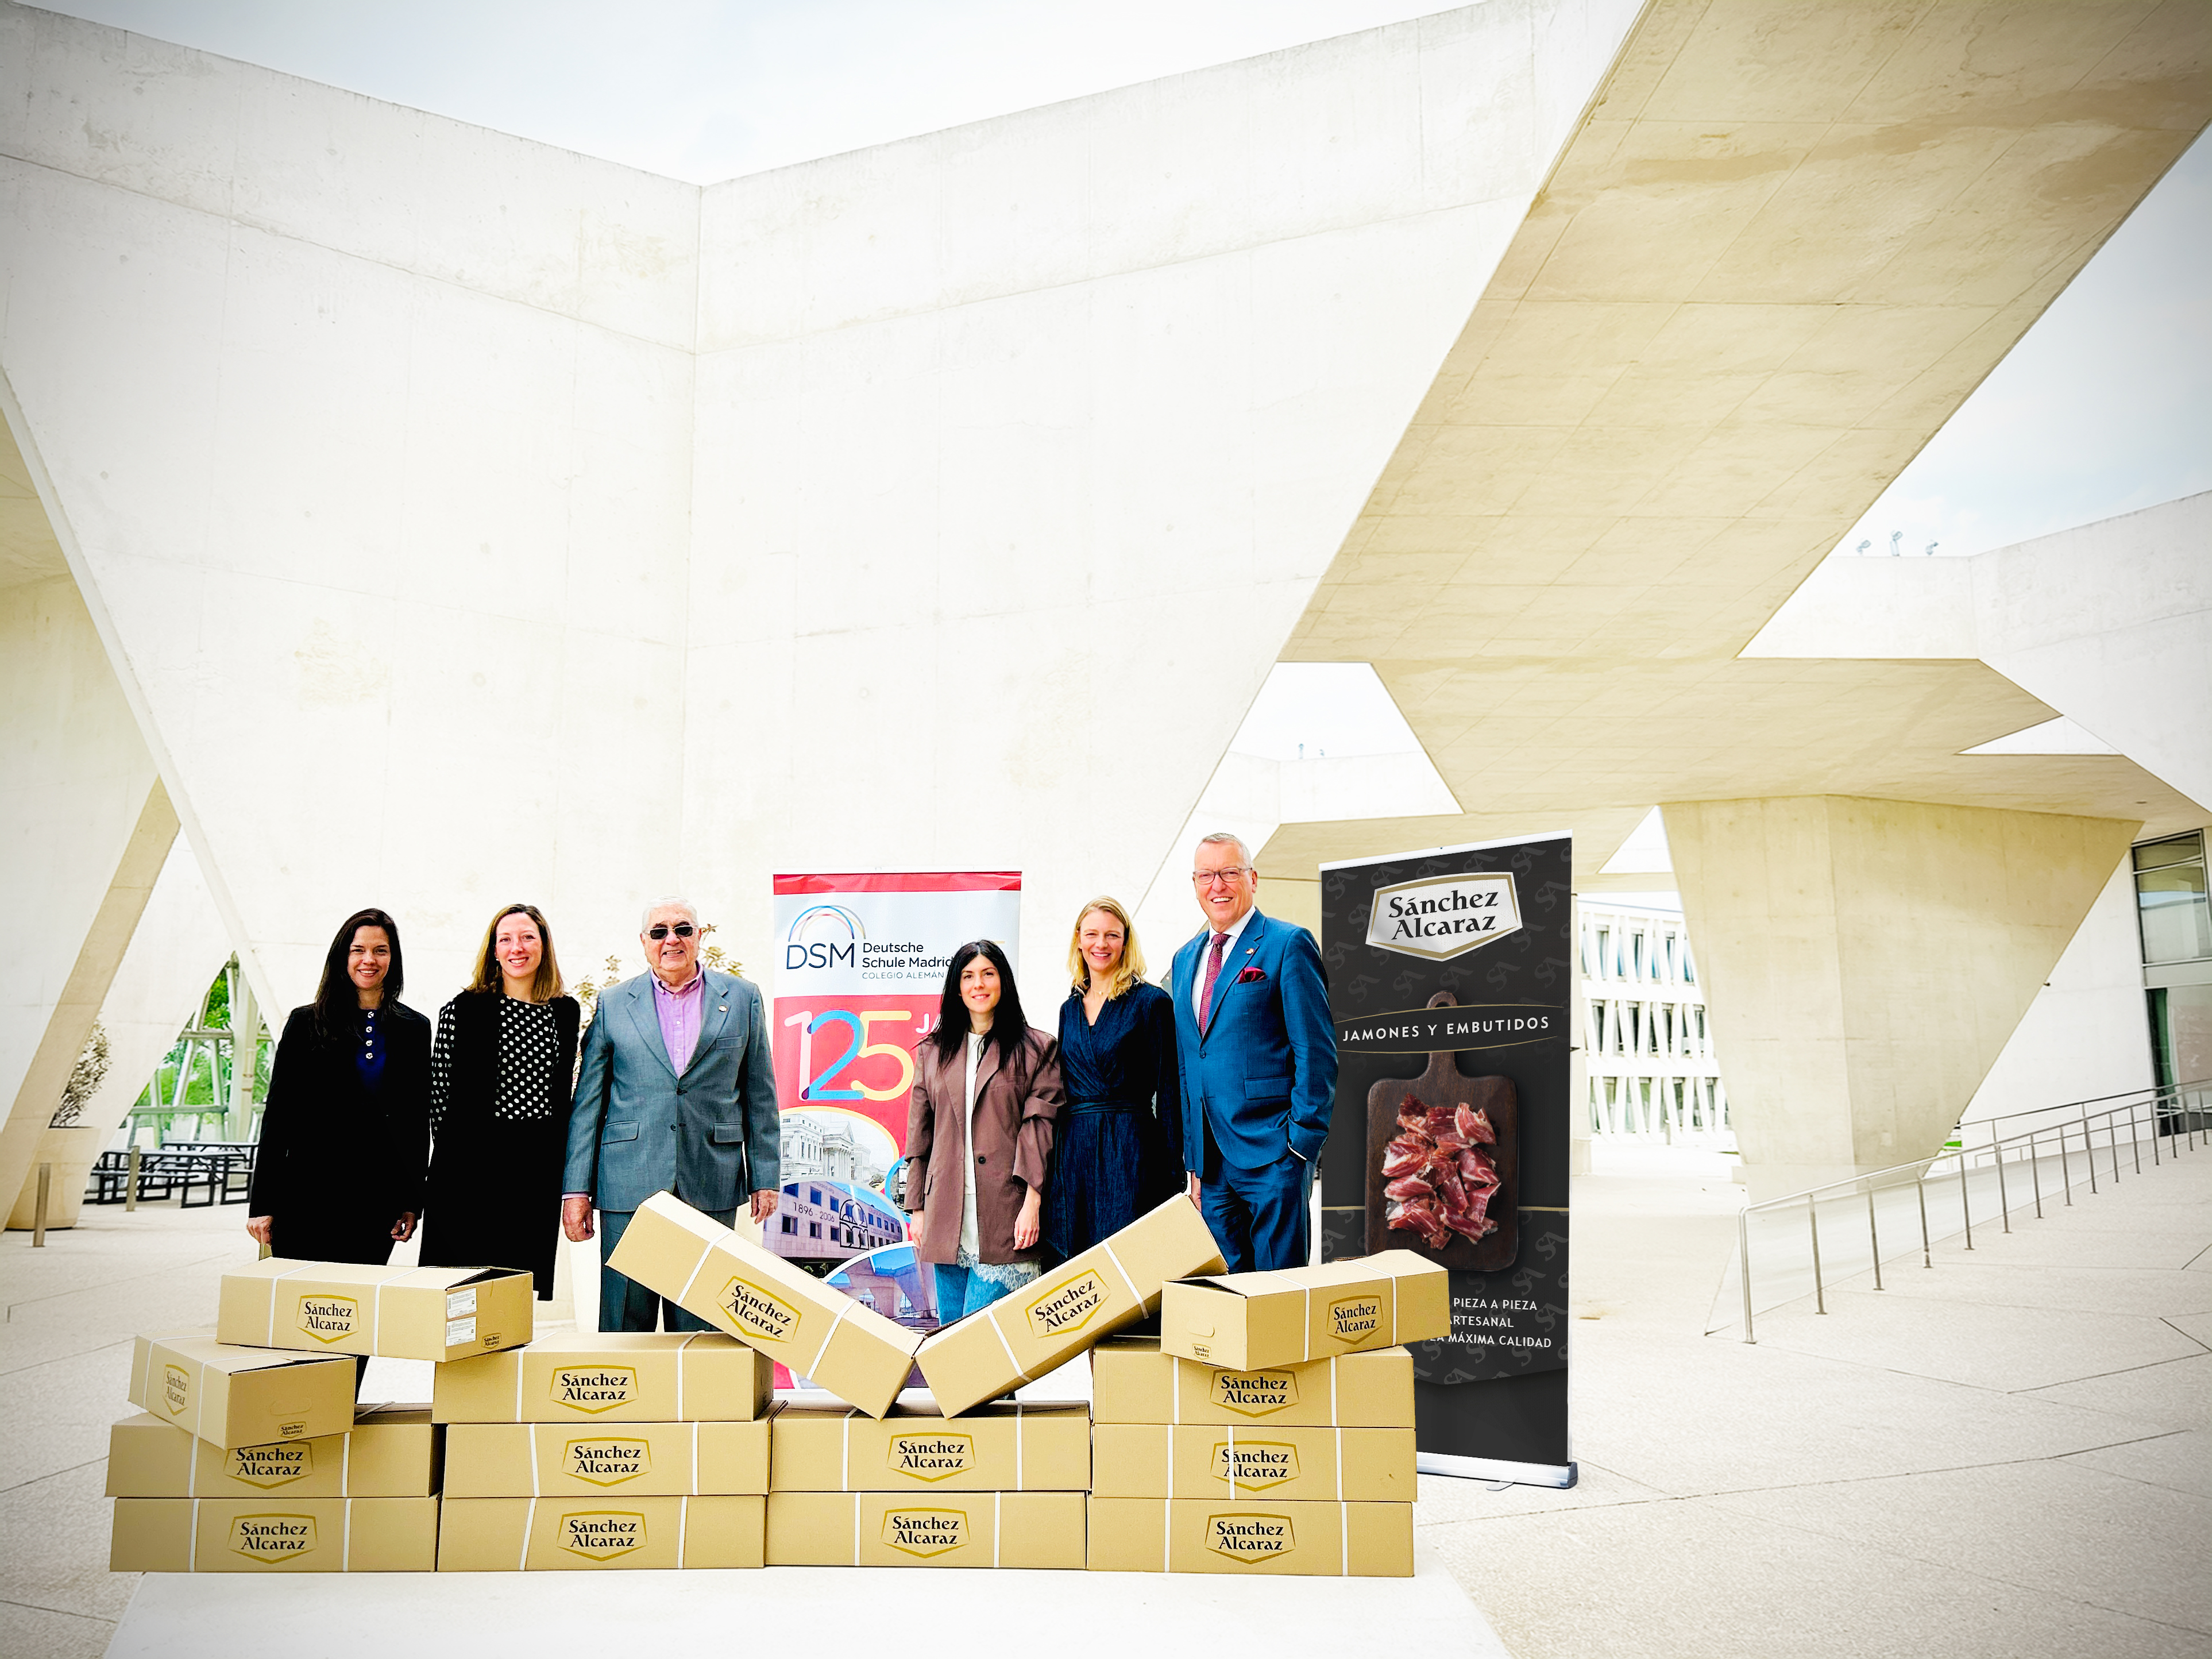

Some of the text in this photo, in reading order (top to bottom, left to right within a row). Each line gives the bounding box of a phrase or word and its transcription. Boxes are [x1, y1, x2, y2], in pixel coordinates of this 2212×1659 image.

[1388, 890, 1499, 918] Sánchez
[1391, 916, 1496, 940] Alcaraz
[862, 943, 924, 954] Deutsche
[786, 943, 855, 970] DSM
[862, 956, 905, 969] Schule
[862, 970, 944, 979] COLEGIO ALEMÁN
[1343, 1016, 1549, 1042] JAMONES Y EMBUTIDOS
[784, 1009, 914, 1101] 125
[793, 1202, 813, 1216] 1896
[820, 1211, 835, 1222] 2006
[731, 1285, 792, 1326] Sánchez
[1035, 1280, 1095, 1321] Sánchez
[1453, 1298, 1537, 1311] PIEZA A PIEZA
[304, 1301, 352, 1318] Sánchez
[1045, 1293, 1101, 1333] Alcaraz
[1334, 1303, 1377, 1321] Sánchez
[305, 1316, 350, 1332] Alcaraz
[726, 1299, 783, 1338] Alcaraz
[1335, 1318, 1376, 1334] Alcaraz
[1448, 1331, 1495, 1345] MÁXIMA
[1499, 1336, 1551, 1348] CALIDAD
[561, 1373, 628, 1387] Sánchez
[1221, 1375, 1288, 1390] Sánchez
[562, 1387, 626, 1401] Alcaraz
[1223, 1390, 1287, 1405] Alcaraz
[236, 1448, 303, 1461] Sánchez
[574, 1445, 641, 1460] Sánchez
[898, 1440, 965, 1454] Sánchez
[237, 1462, 302, 1475] Alcaraz
[575, 1460, 639, 1473] Alcaraz
[900, 1454, 964, 1469] Alcaraz
[240, 1522, 307, 1536] Sánchez
[569, 1519, 636, 1534] Sánchez
[892, 1515, 959, 1530] Sánchez
[1216, 1521, 1284, 1537] Sánchez
[241, 1537, 306, 1550] Alcaraz
[570, 1534, 635, 1548] Alcaraz
[894, 1530, 958, 1545] Alcaraz
[1218, 1537, 1283, 1552] Alcaraz
